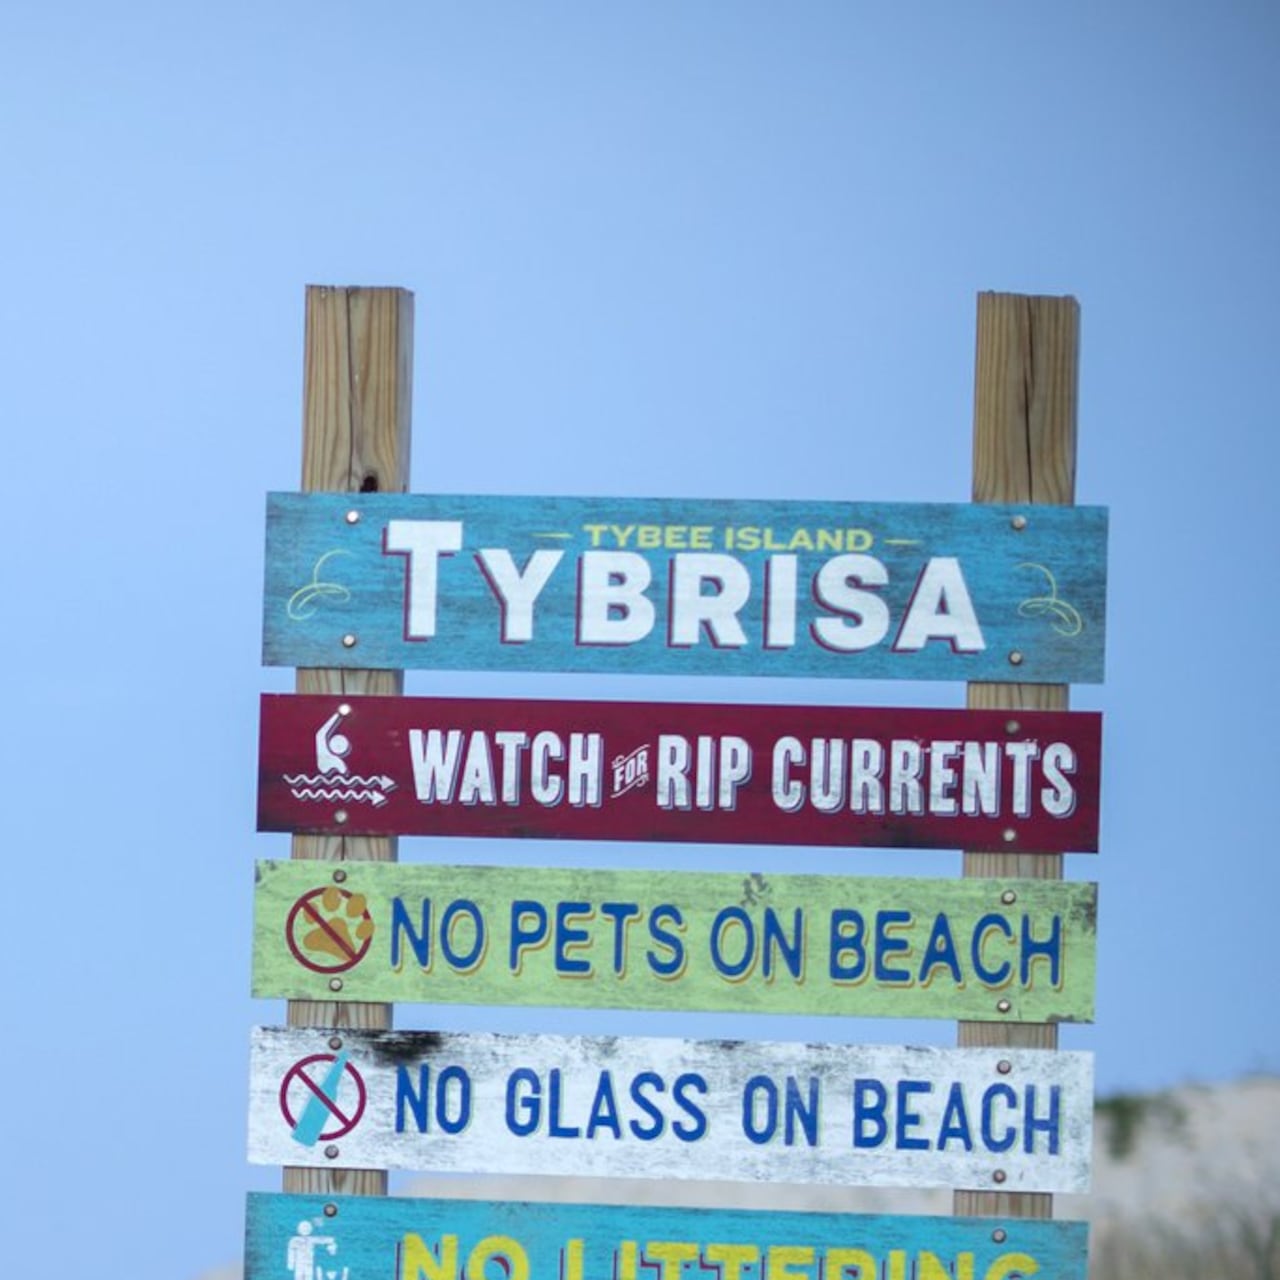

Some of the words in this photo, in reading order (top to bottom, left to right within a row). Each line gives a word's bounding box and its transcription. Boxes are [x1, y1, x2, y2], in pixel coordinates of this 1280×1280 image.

[583, 524, 714, 549] TYBEE
[725, 527, 874, 552] ISLAND
[382, 519, 987, 654] TYBRISA
[408, 728, 604, 808] WATCH
[612, 749, 649, 793] FOR
[656, 734, 752, 812] RIP
[772, 737, 1077, 819] CURRENTS
[390, 898, 487, 976] NO
[508, 900, 687, 979] PETS
[710, 905, 805, 983] ON
[828, 910, 1065, 990] BEACH
[394, 1064, 474, 1136] NO
[505, 1068, 711, 1144] GLASS
[742, 1073, 820, 1147] ON
[852, 1079, 1062, 1156] BEACH
